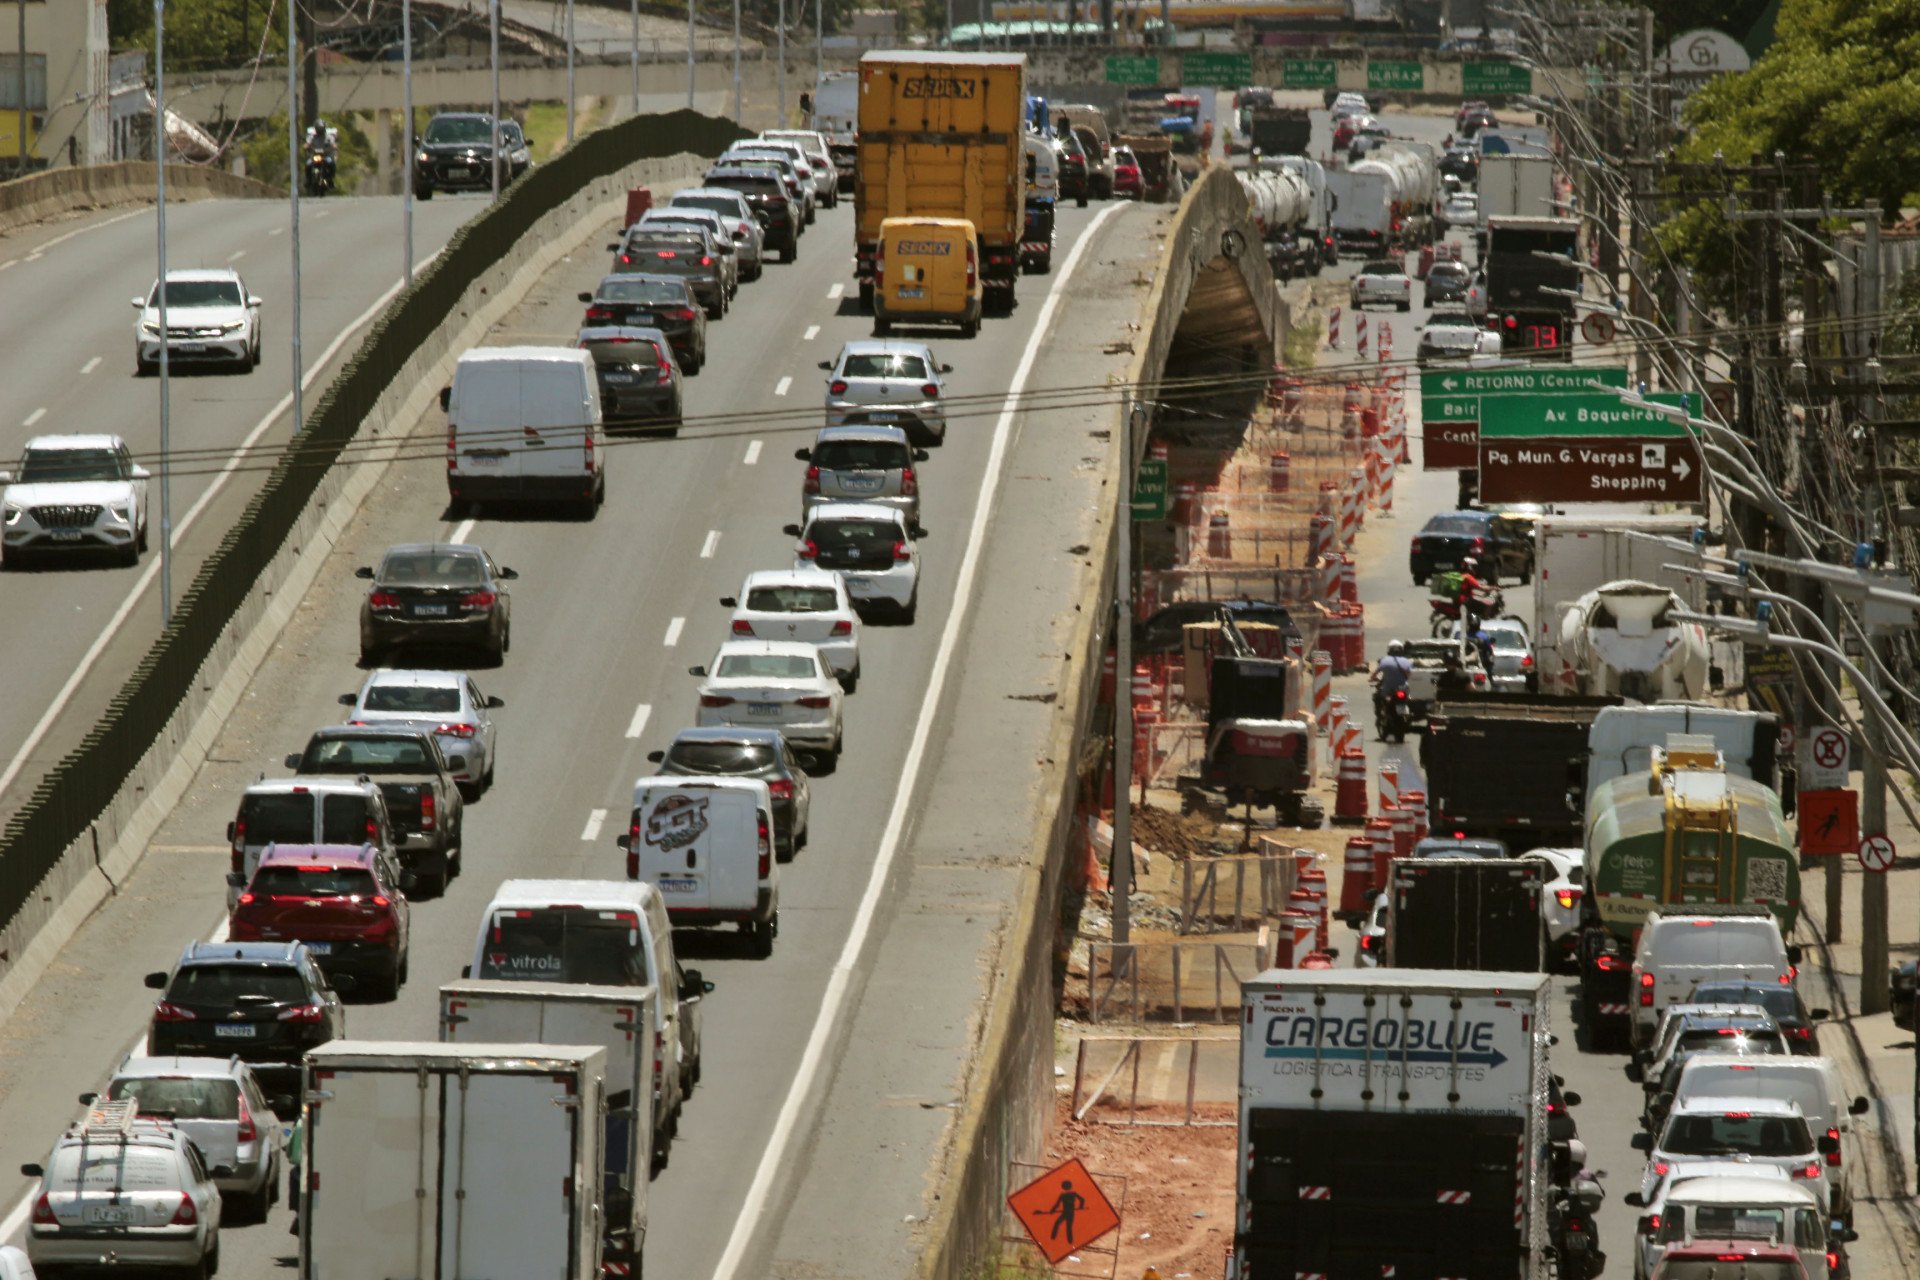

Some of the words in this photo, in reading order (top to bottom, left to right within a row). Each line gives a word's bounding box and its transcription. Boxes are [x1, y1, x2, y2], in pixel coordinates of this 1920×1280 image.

[905, 79, 973, 98] SEDEX
[899, 241, 950, 255] SEDEX
[1525, 325, 1557, 348] 73
[1465, 376, 1535, 389] RETORNO
[1444, 403, 1477, 416] Bair
[1443, 431, 1477, 443] Cent
[1488, 450, 1513, 466] Pq.
[1518, 450, 1555, 464] Mun.
[1559, 450, 1574, 463] G.
[1579, 450, 1635, 468] Vargas
[1590, 475, 1666, 491] Shopping
[511, 954, 561, 969] vitrola
[1265, 1016, 1495, 1051] CARGOBLUE
[1373, 1064, 1485, 1081] TRANSPORTES
